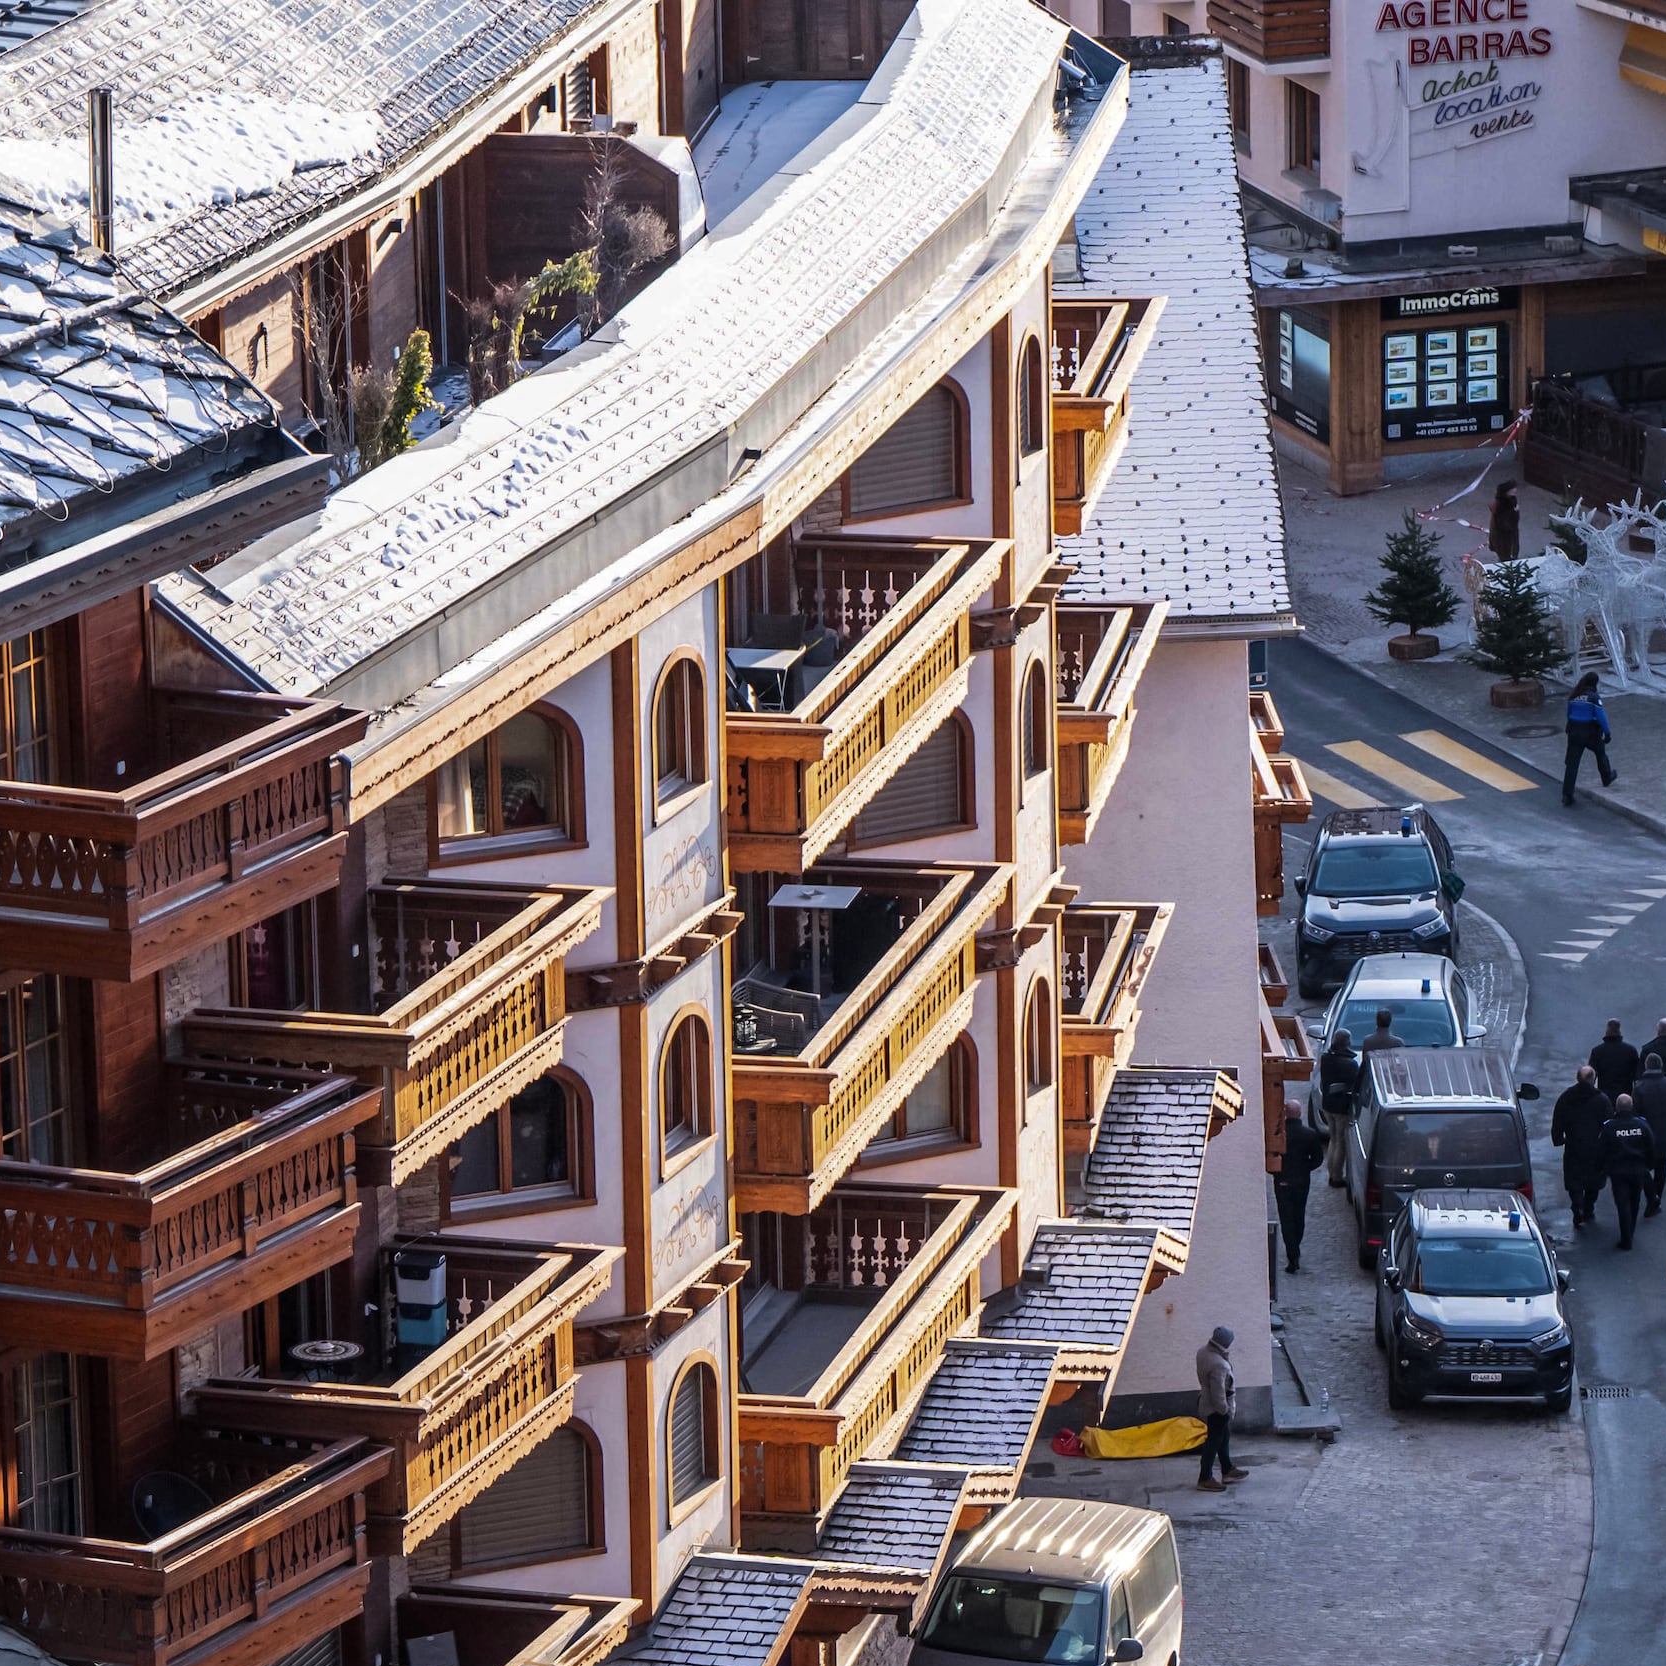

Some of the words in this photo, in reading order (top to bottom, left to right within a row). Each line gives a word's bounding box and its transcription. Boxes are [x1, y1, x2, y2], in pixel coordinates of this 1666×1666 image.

[1376, 0, 1528, 31] AGENCE
[1407, 27, 1552, 65] BARRAS
[1423, 59, 1499, 103] achat
[1435, 81, 1542, 125] location
[1470, 109, 1534, 139] vente
[1400, 291, 1499, 311] ImmoCrans
[1616, 1128, 1642, 1137] POLICE
